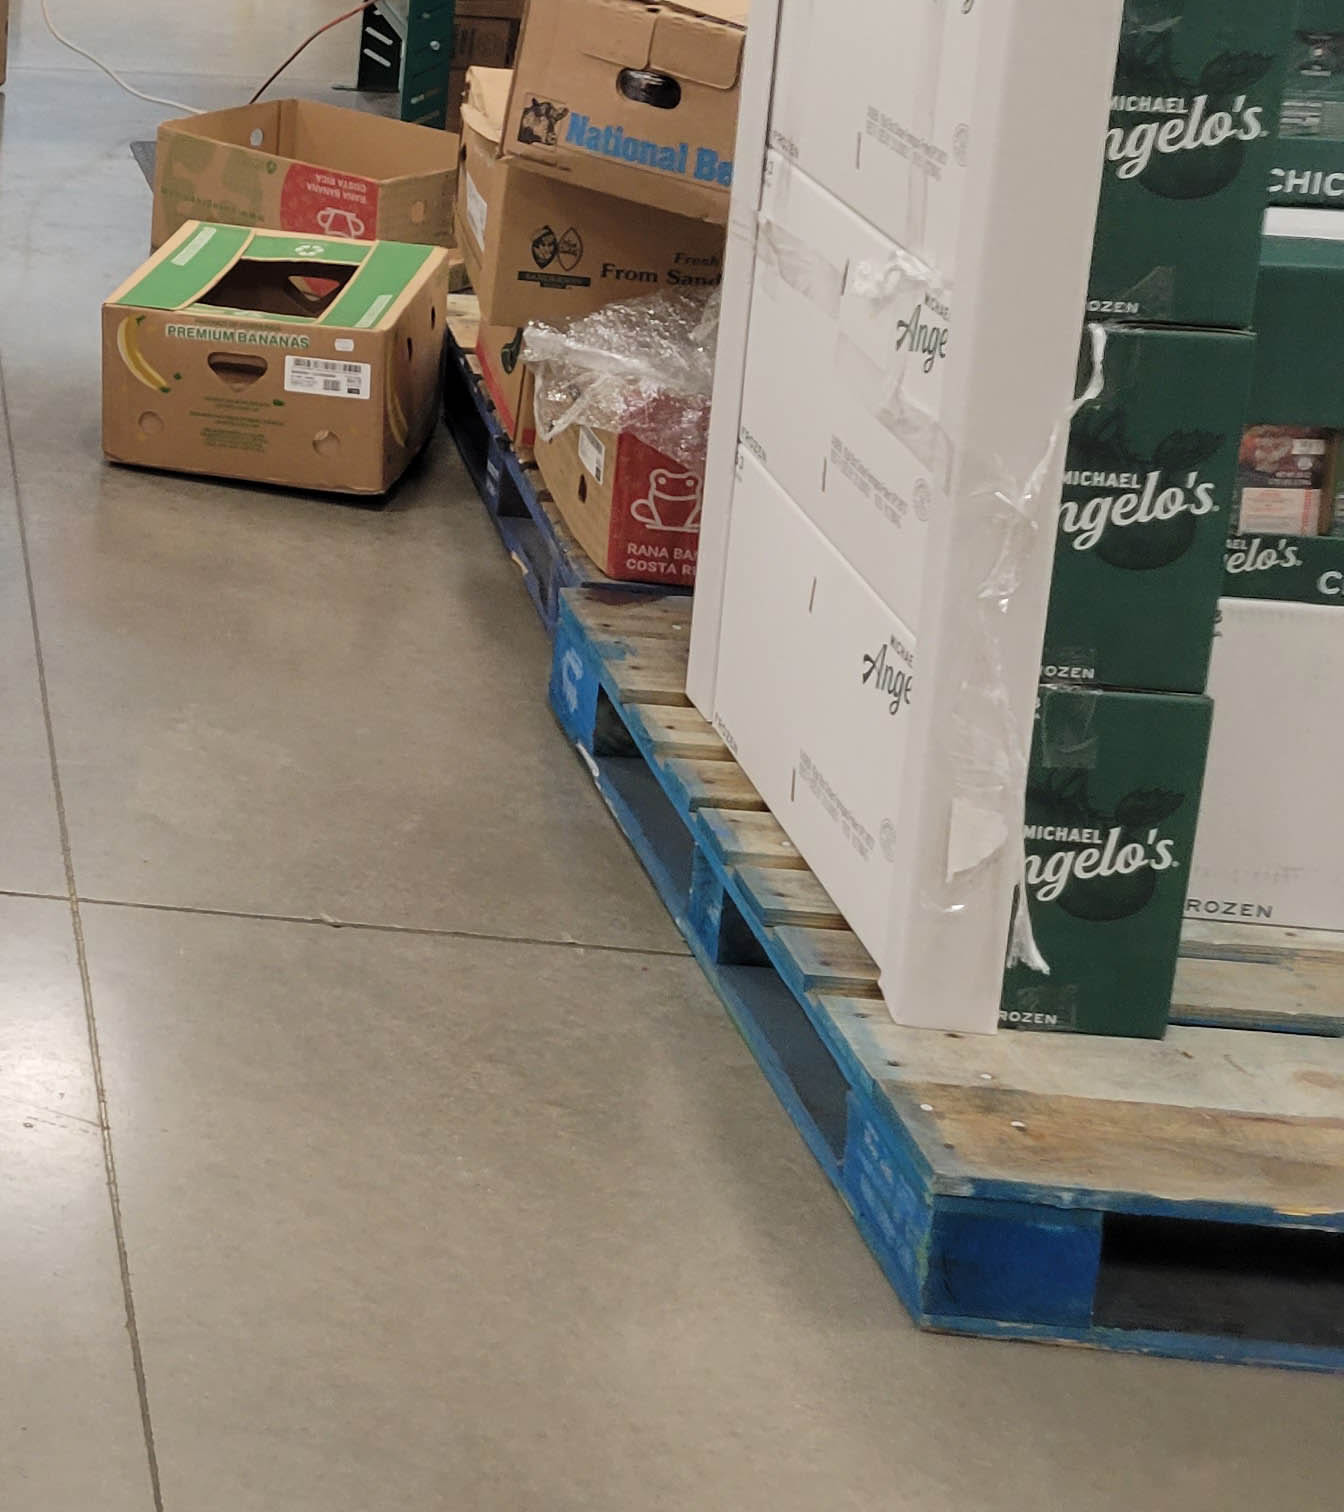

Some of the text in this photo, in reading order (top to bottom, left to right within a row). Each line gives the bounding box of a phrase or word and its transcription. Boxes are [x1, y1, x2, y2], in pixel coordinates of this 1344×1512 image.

[566, 112, 689, 175] National
[1107, 94, 1264, 180] ngelo's
[600, 262, 658, 284] From
[666, 270, 723, 287] Sand
[1087, 300, 1140, 314] OZEN
[167, 325, 236, 341] PREMIUM
[237, 332, 311, 349] BANANAS
[1059, 470, 1215, 551] ngelo's
[627, 543, 669, 559] RANA
[1226, 538, 1298, 574] elo's
[626, 558, 678, 576] COSTA
[1044, 664, 1096, 679] OZEN
[1024, 825, 1104, 844] MICHAEL
[1023, 826, 1176, 902] ngelo's
[1186, 898, 1274, 919] ROZEN
[1000, 1010, 1058, 1025] ROZEN
